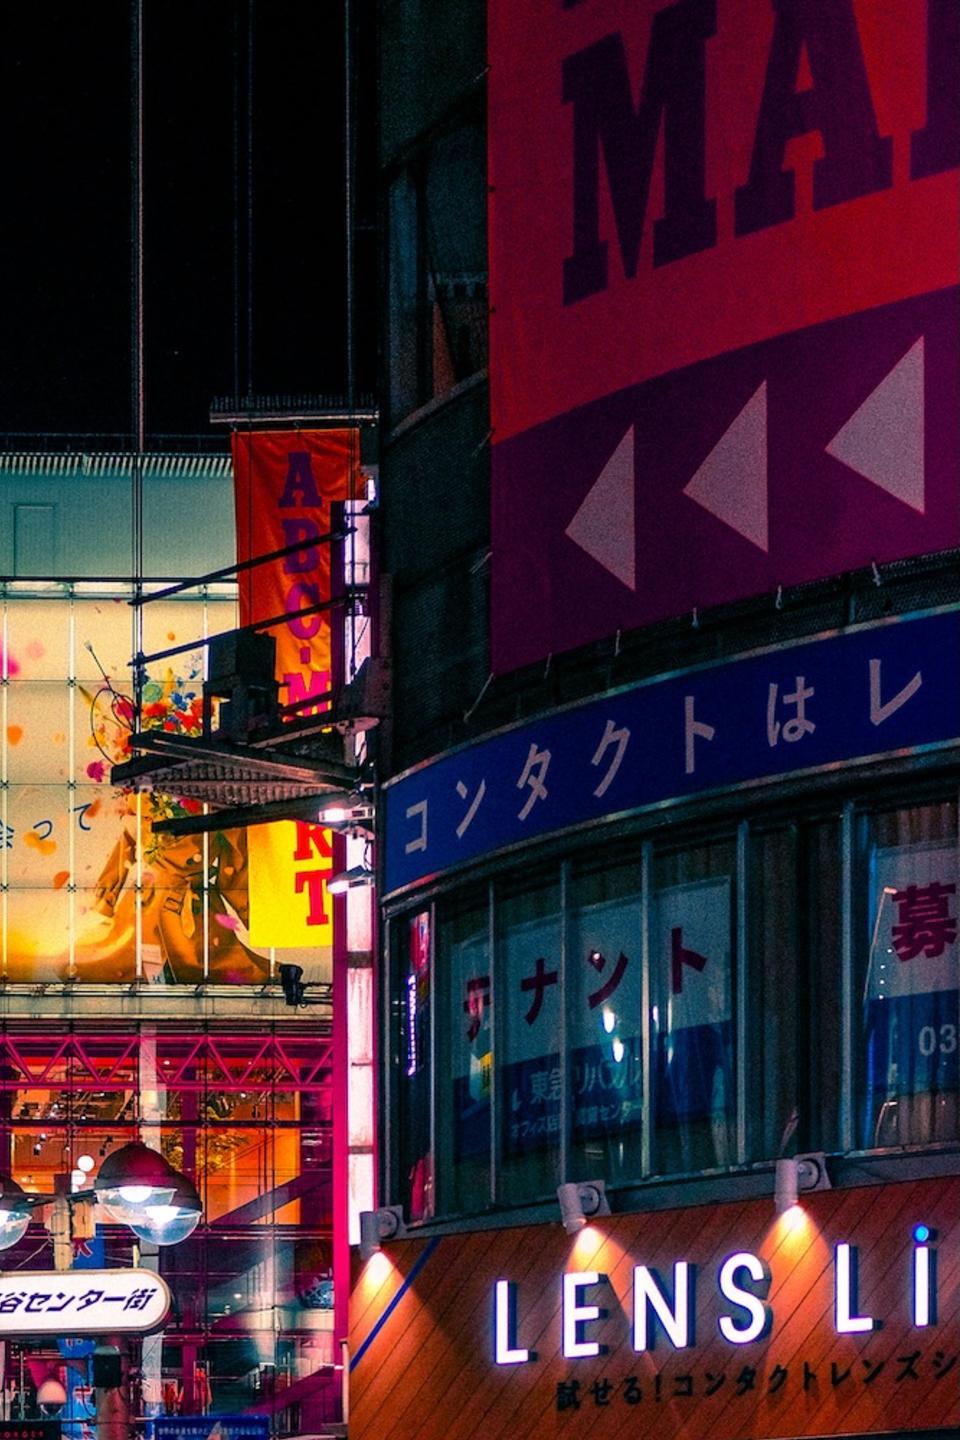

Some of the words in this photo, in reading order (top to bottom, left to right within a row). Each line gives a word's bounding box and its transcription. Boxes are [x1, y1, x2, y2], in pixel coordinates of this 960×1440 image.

[463, 928, 708, 1044] テナント
[494, 1252, 770, 1366] LENS
